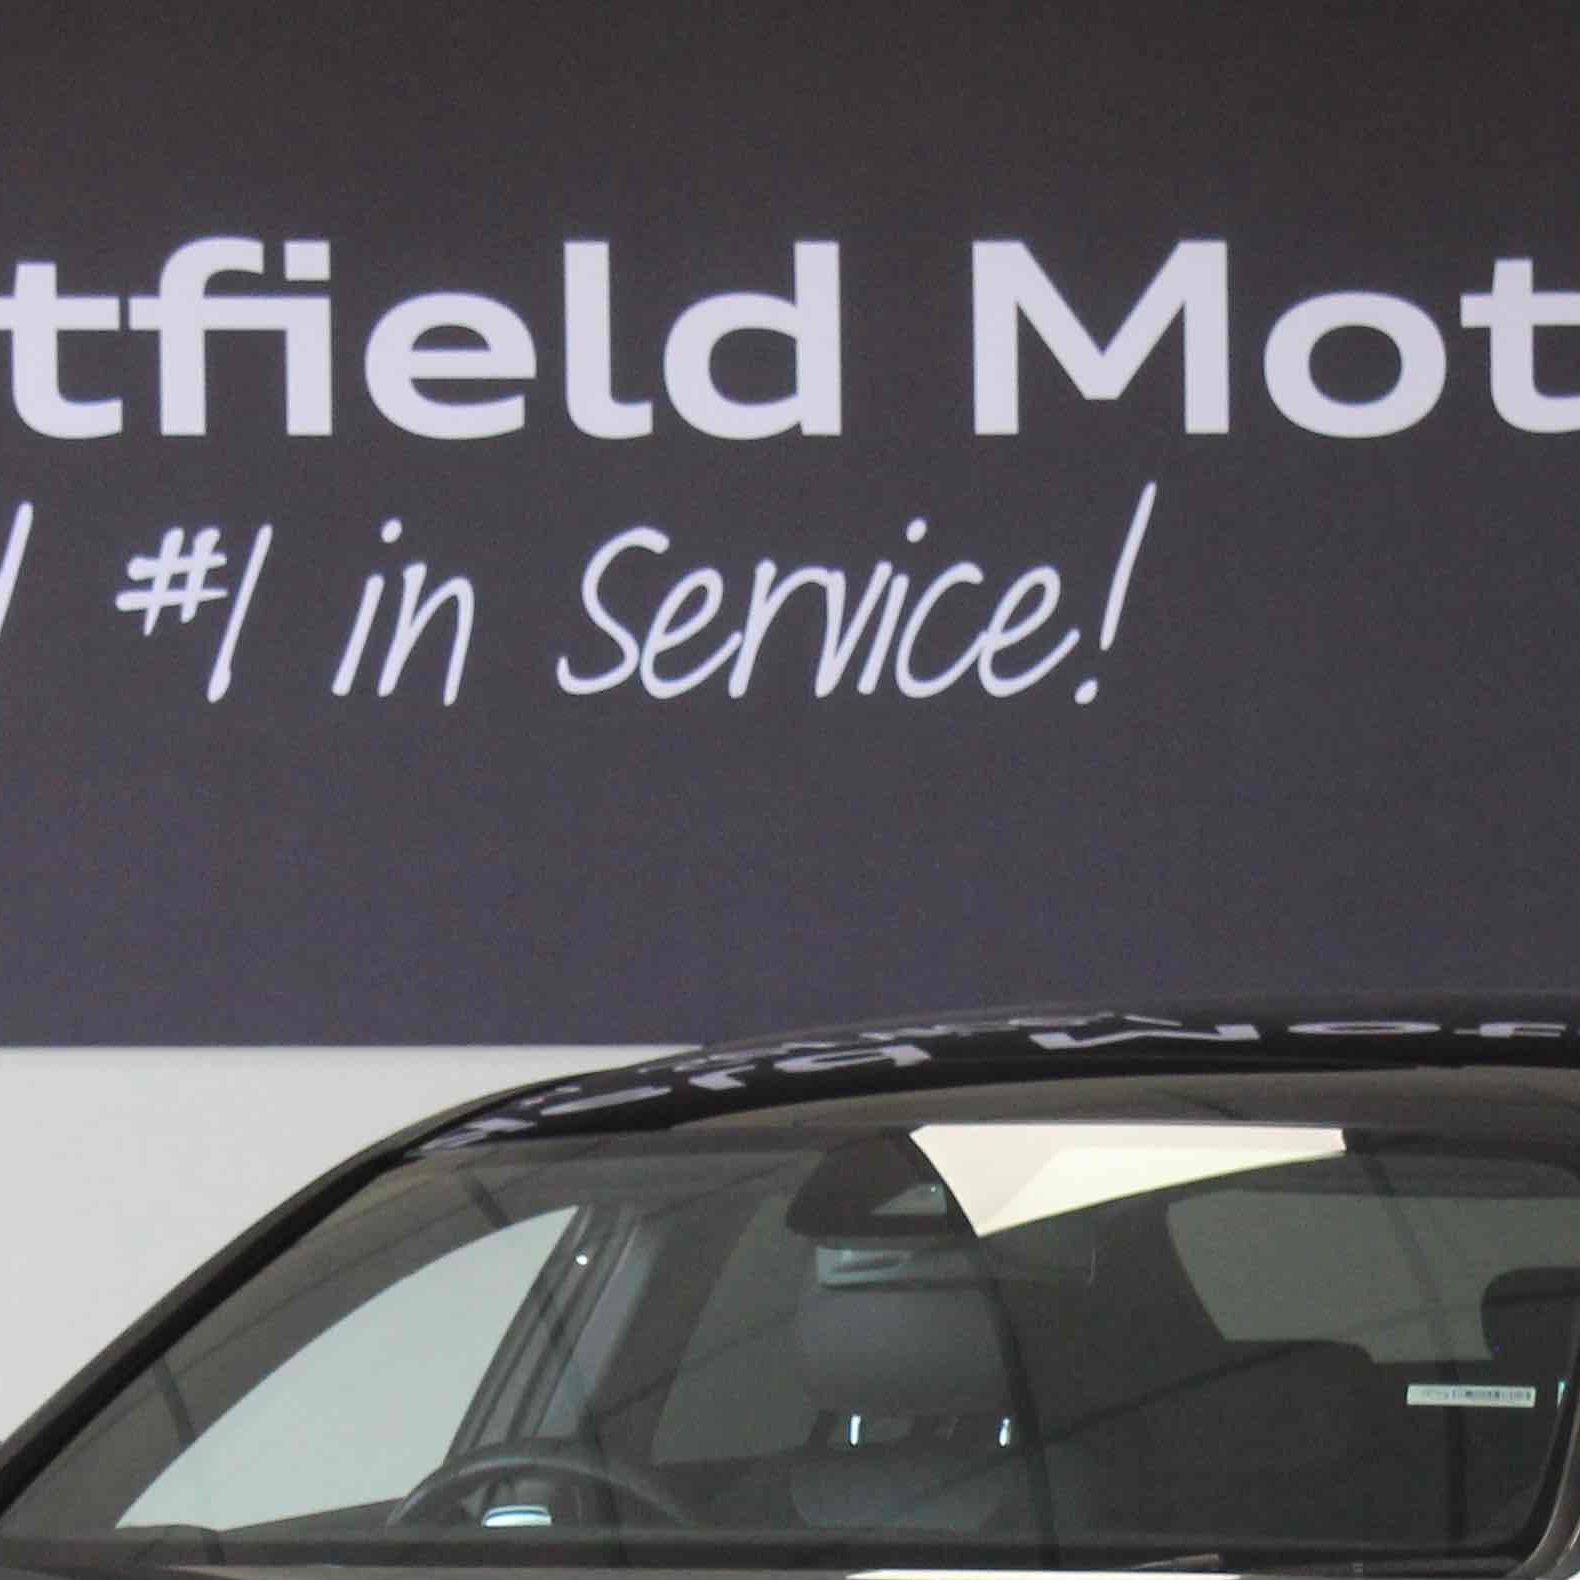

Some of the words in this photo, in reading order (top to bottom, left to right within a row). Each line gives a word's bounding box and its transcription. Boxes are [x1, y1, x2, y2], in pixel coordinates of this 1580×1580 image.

[115, 524, 274, 703] #1
[331, 518, 475, 706] in
[555, 483, 1157, 704] Service!
